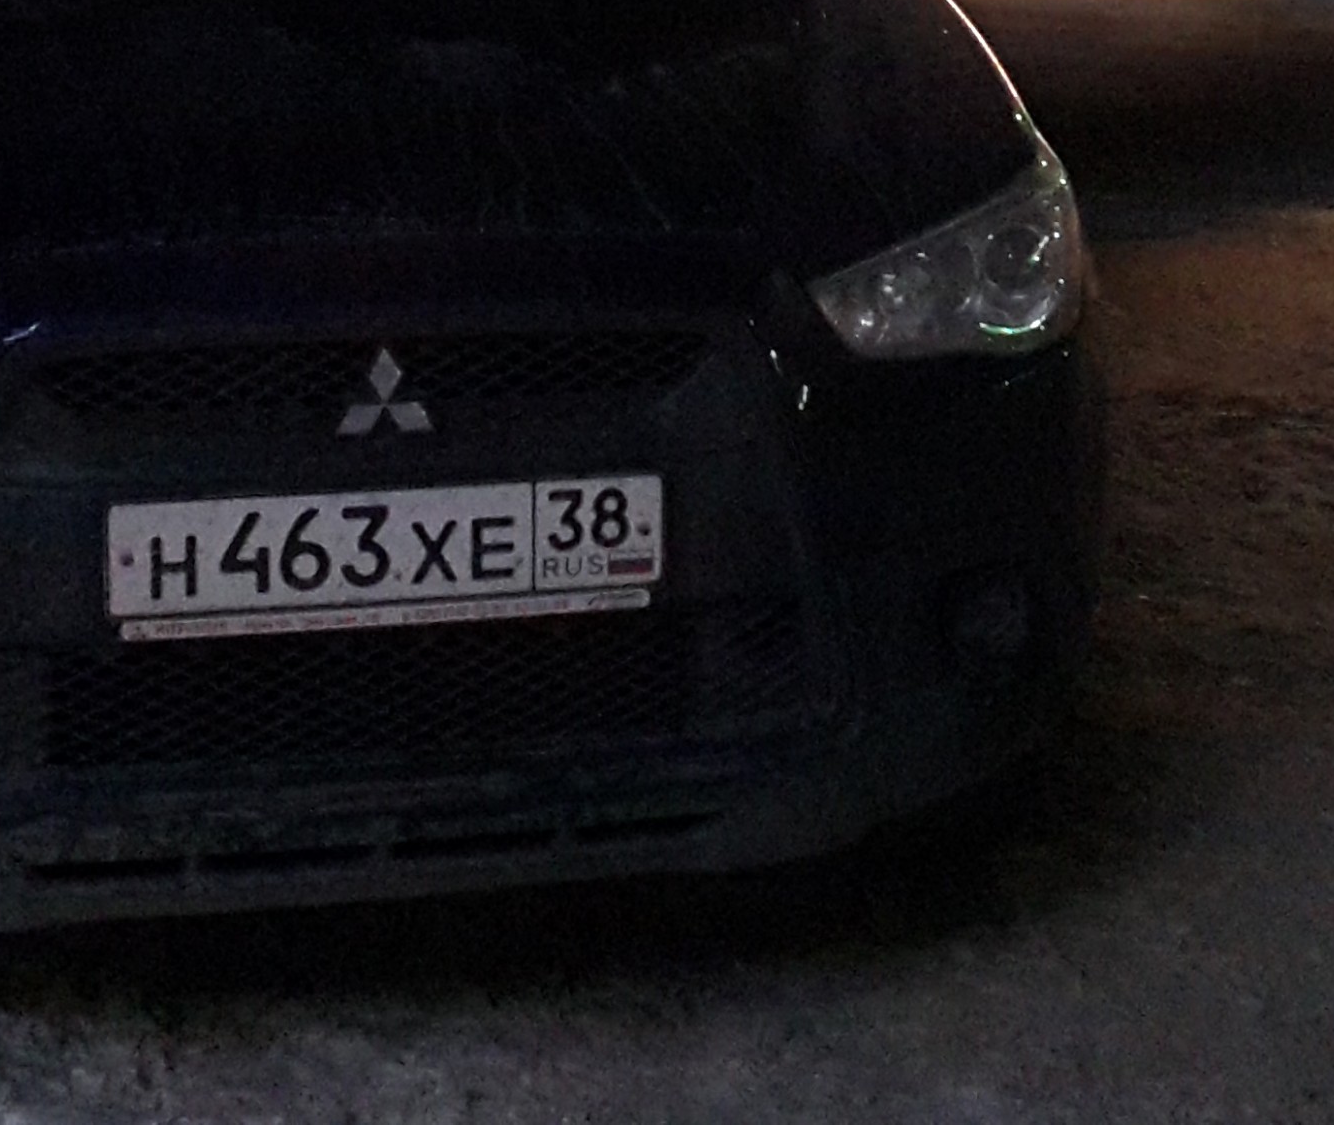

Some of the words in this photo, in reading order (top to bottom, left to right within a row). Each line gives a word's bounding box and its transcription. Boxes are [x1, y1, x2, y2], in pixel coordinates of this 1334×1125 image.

[150, 506, 514, 598] Н463ХЕ
[548, 488, 629, 550] 38
[543, 555, 604, 577] RUS
